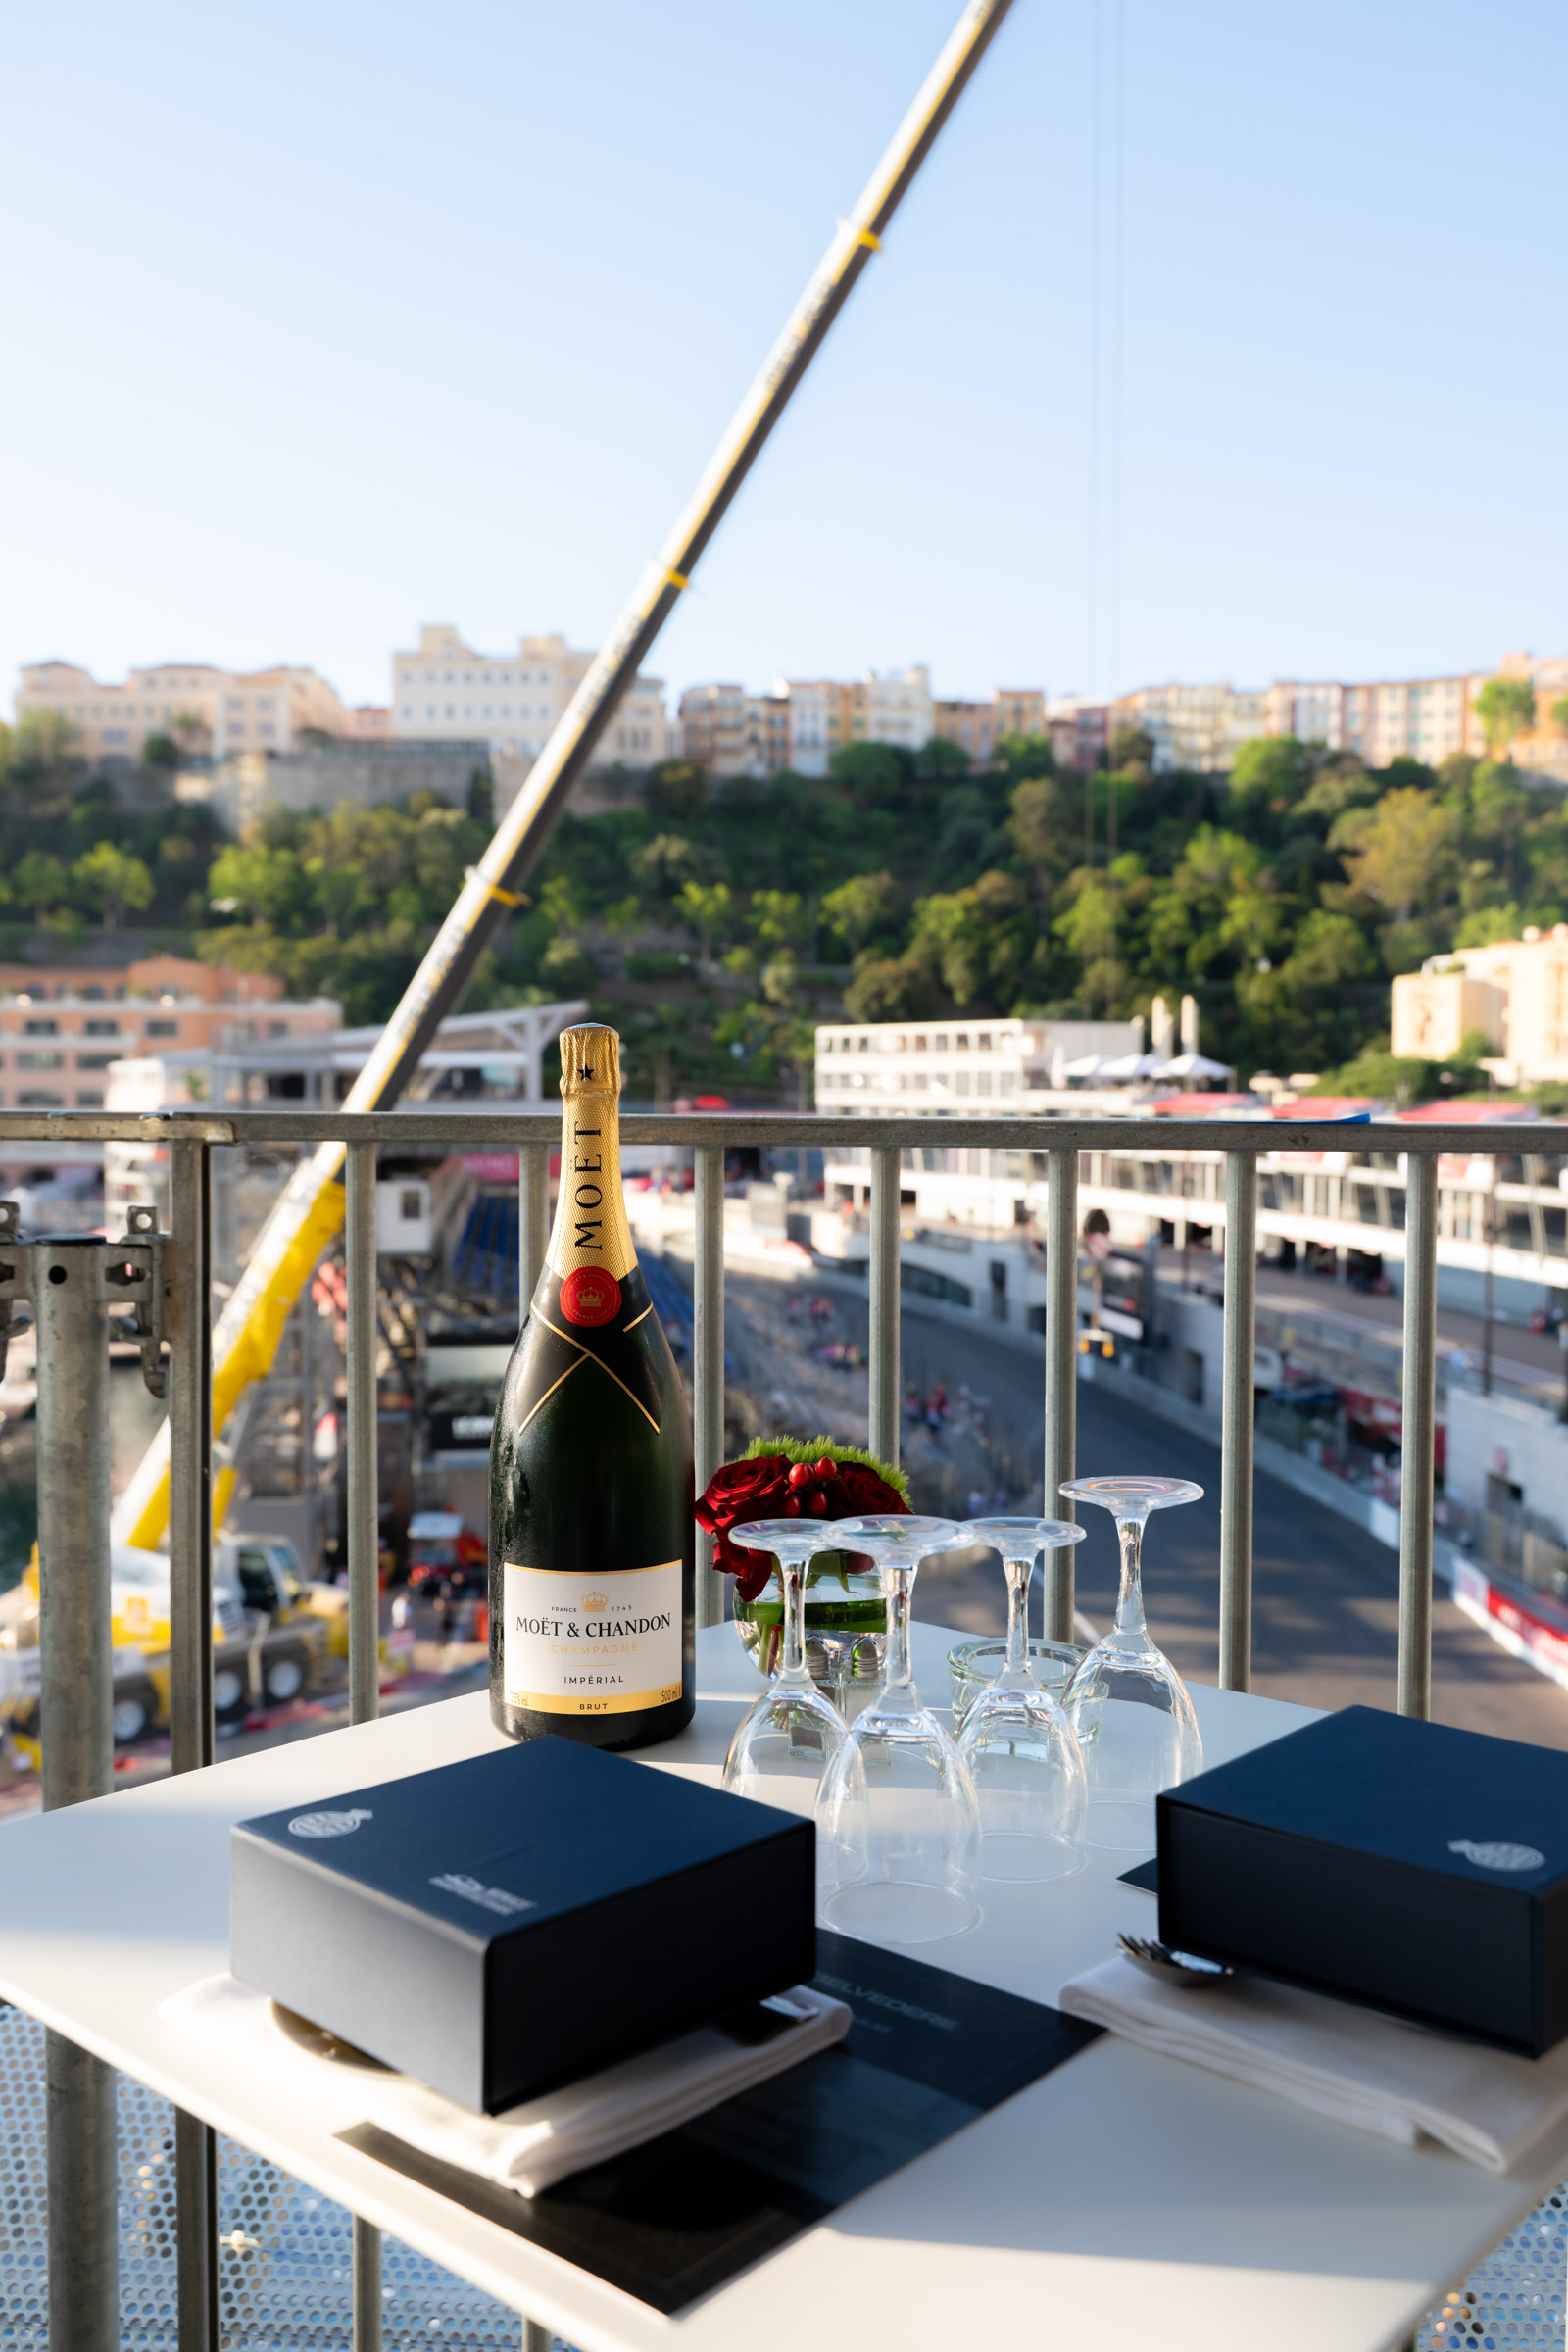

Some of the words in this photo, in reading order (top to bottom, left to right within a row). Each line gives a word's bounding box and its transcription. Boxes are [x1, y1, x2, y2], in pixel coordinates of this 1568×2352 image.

[569, 1121, 603, 1250] MOËT
[515, 1616, 563, 1637] MOËT
[566, 1621, 581, 1638] &
[585, 1612, 671, 1638] CHANDON
[551, 1642, 638, 1655] CHAMPAGNE
[564, 1675, 624, 1685] IMPÉRIAL
